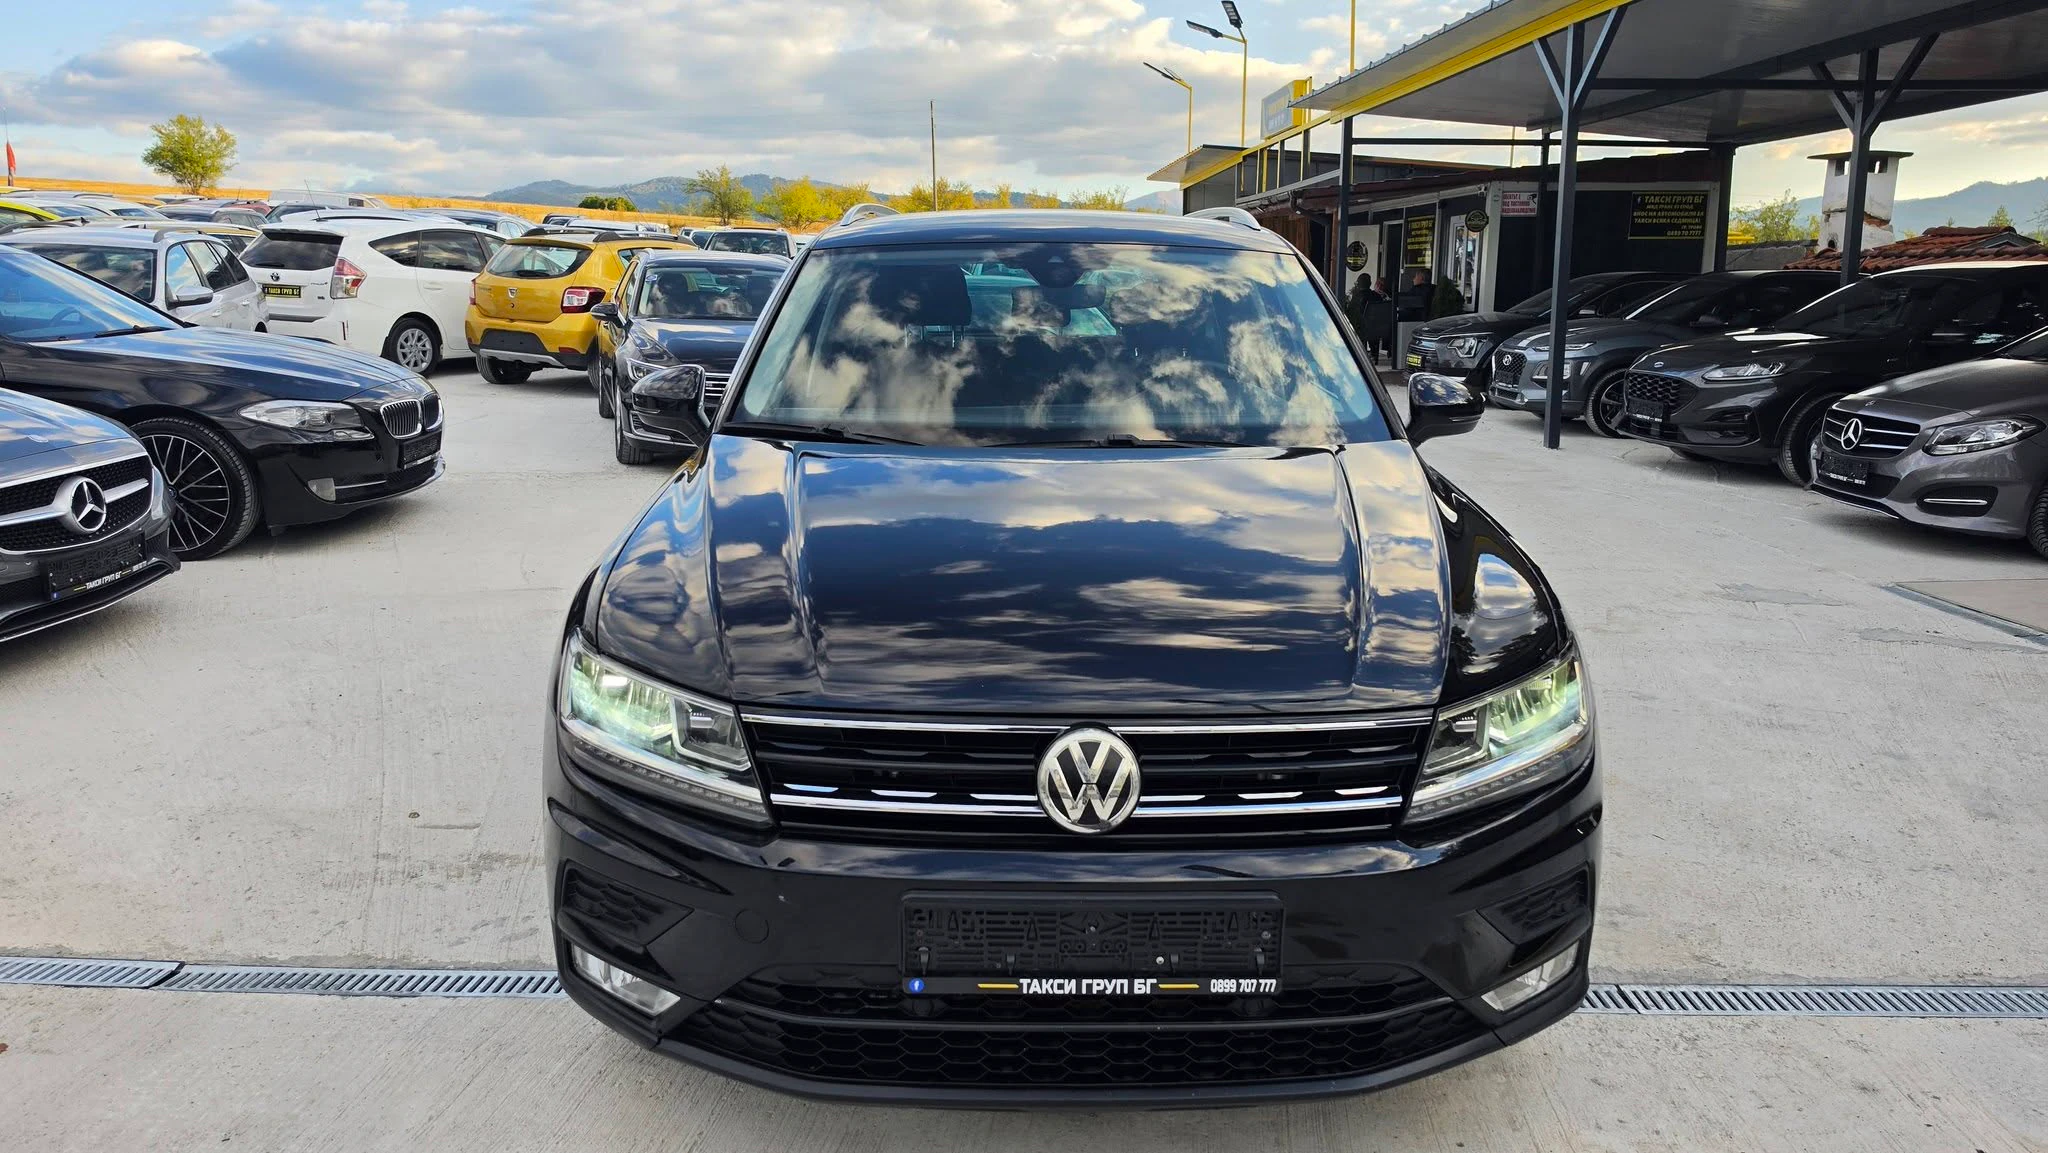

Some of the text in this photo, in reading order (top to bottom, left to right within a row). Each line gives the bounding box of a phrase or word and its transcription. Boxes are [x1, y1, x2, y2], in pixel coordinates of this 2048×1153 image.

[1644, 195, 1671, 203] ТАКСИ
[1672, 195, 1693, 203] ГРУП
[1694, 195, 1704, 203] БГ
[1020, 979, 1076, 994] ТАКСИ
[1082, 979, 1128, 994] ГРУП
[1134, 979, 1157, 994] БГ
[1210, 979, 1237, 993] 0899
[1238, 979, 1258, 993] 707
[1259, 979, 1277, 993] 777
